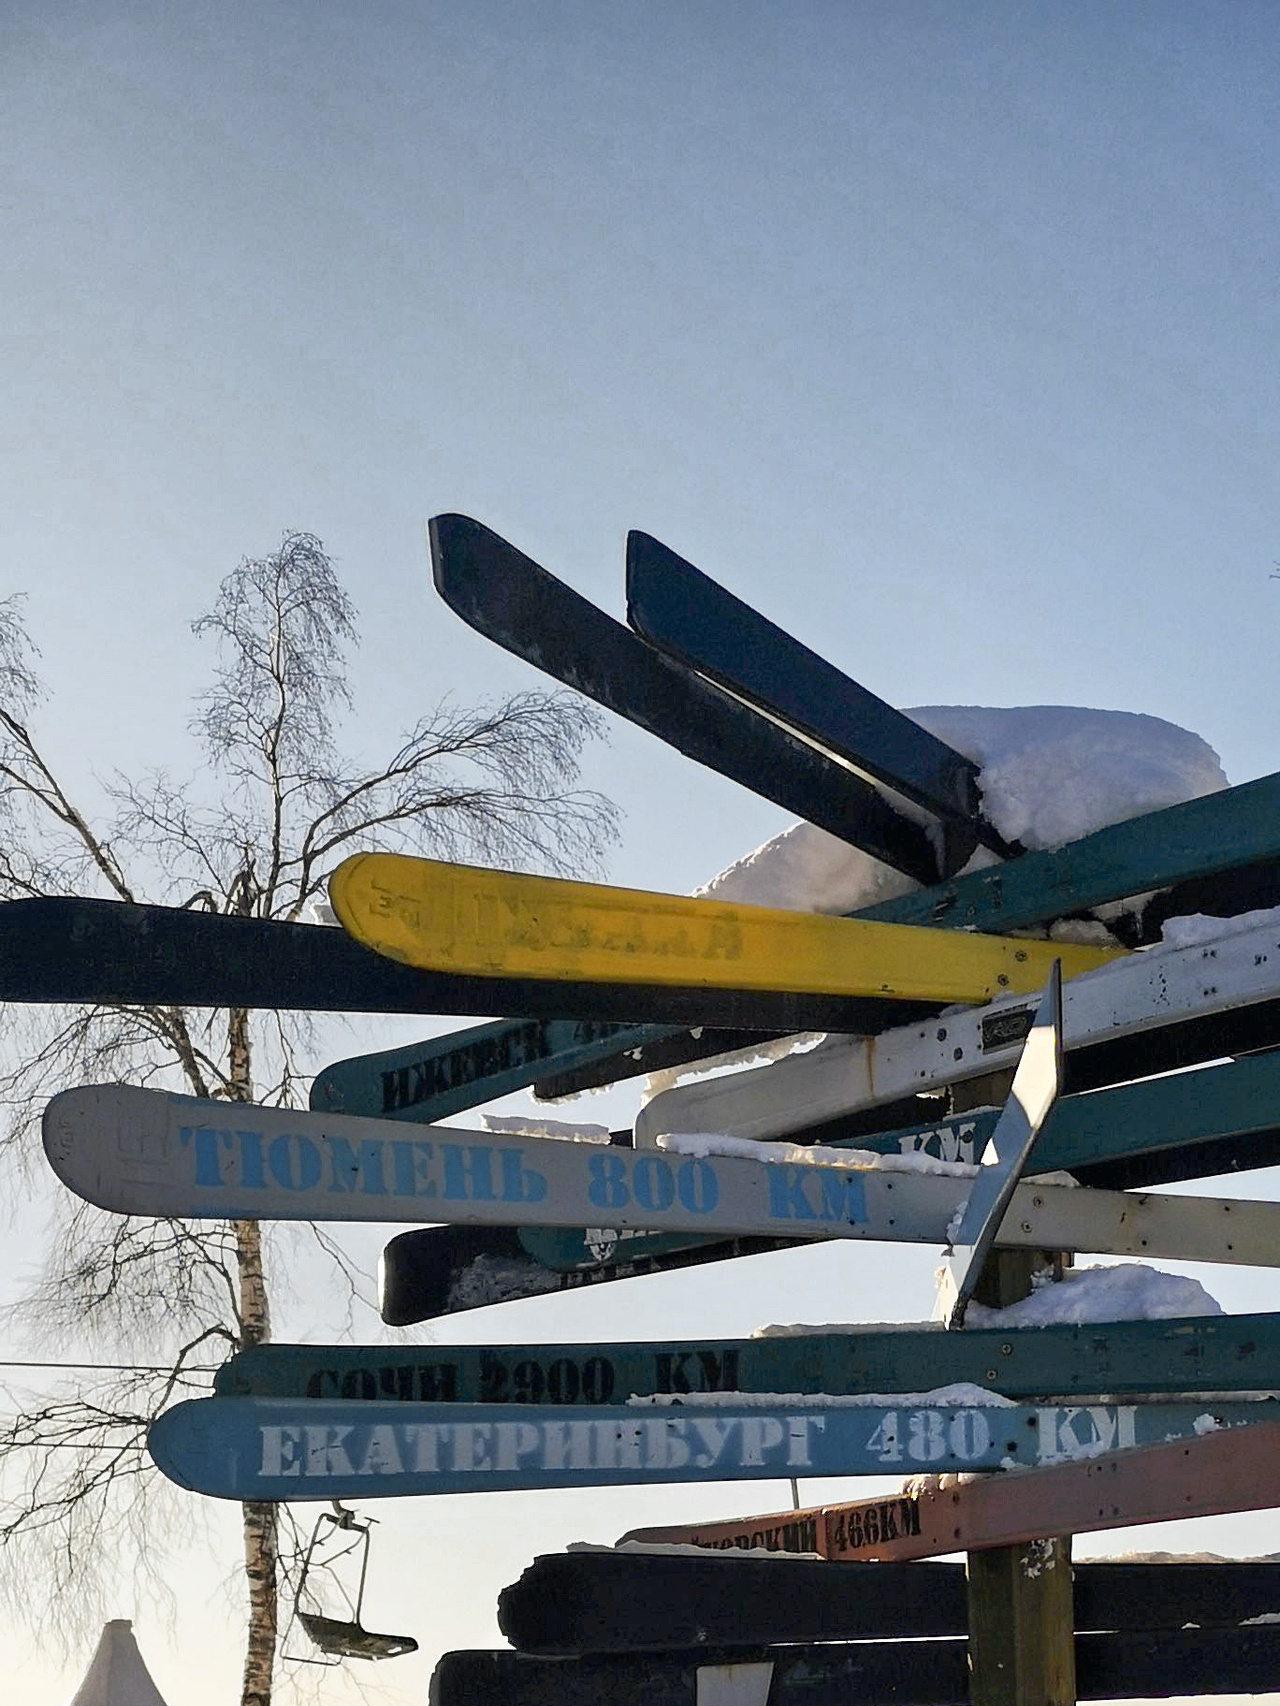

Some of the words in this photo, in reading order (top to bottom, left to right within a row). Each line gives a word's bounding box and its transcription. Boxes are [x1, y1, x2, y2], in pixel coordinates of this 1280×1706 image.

[180, 1126, 548, 1203] ТЮМЕНЬ
[587, 1152, 719, 1214] 800
[764, 1163, 869, 1223] КМ
[655, 1349, 741, 1394] КМ
[257, 1416, 825, 1478] ЕКАТЕРИНБУРГ
[865, 1409, 991, 1462] 480
[1036, 1405, 1138, 1456] КМ
